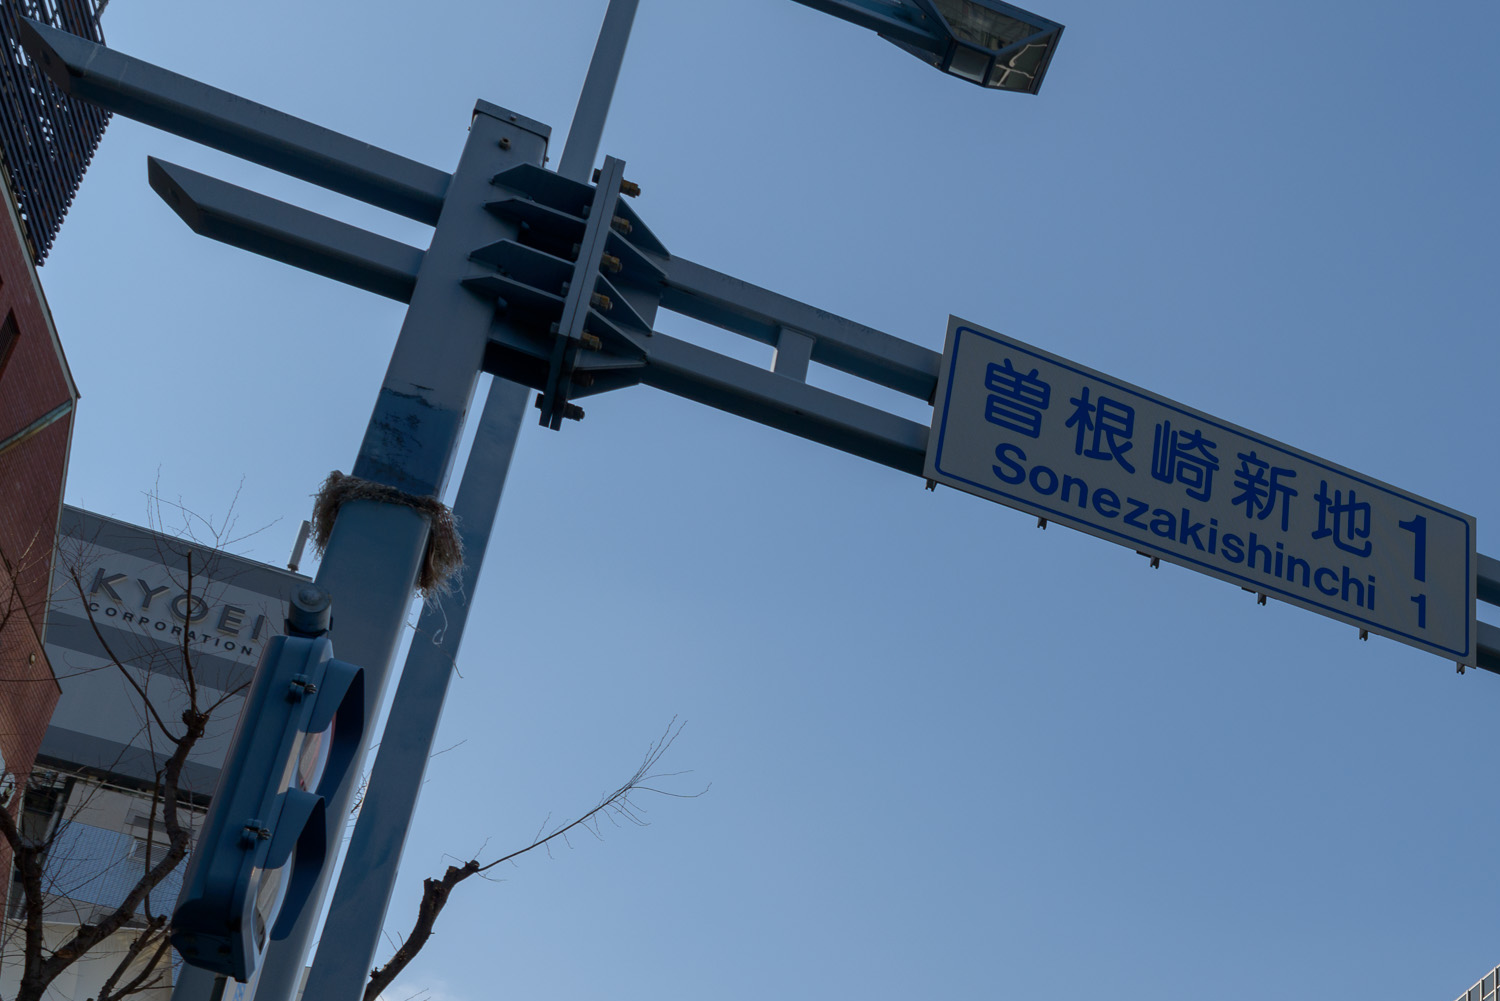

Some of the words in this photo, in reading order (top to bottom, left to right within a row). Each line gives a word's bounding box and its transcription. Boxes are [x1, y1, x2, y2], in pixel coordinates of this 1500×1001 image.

[992, 442, 1377, 612] Sonezakishinchi
[1410, 593, 1427, 629] 1
[88, 601, 254, 657] CORPORATION
[89, 567, 266, 641] KYOEI
